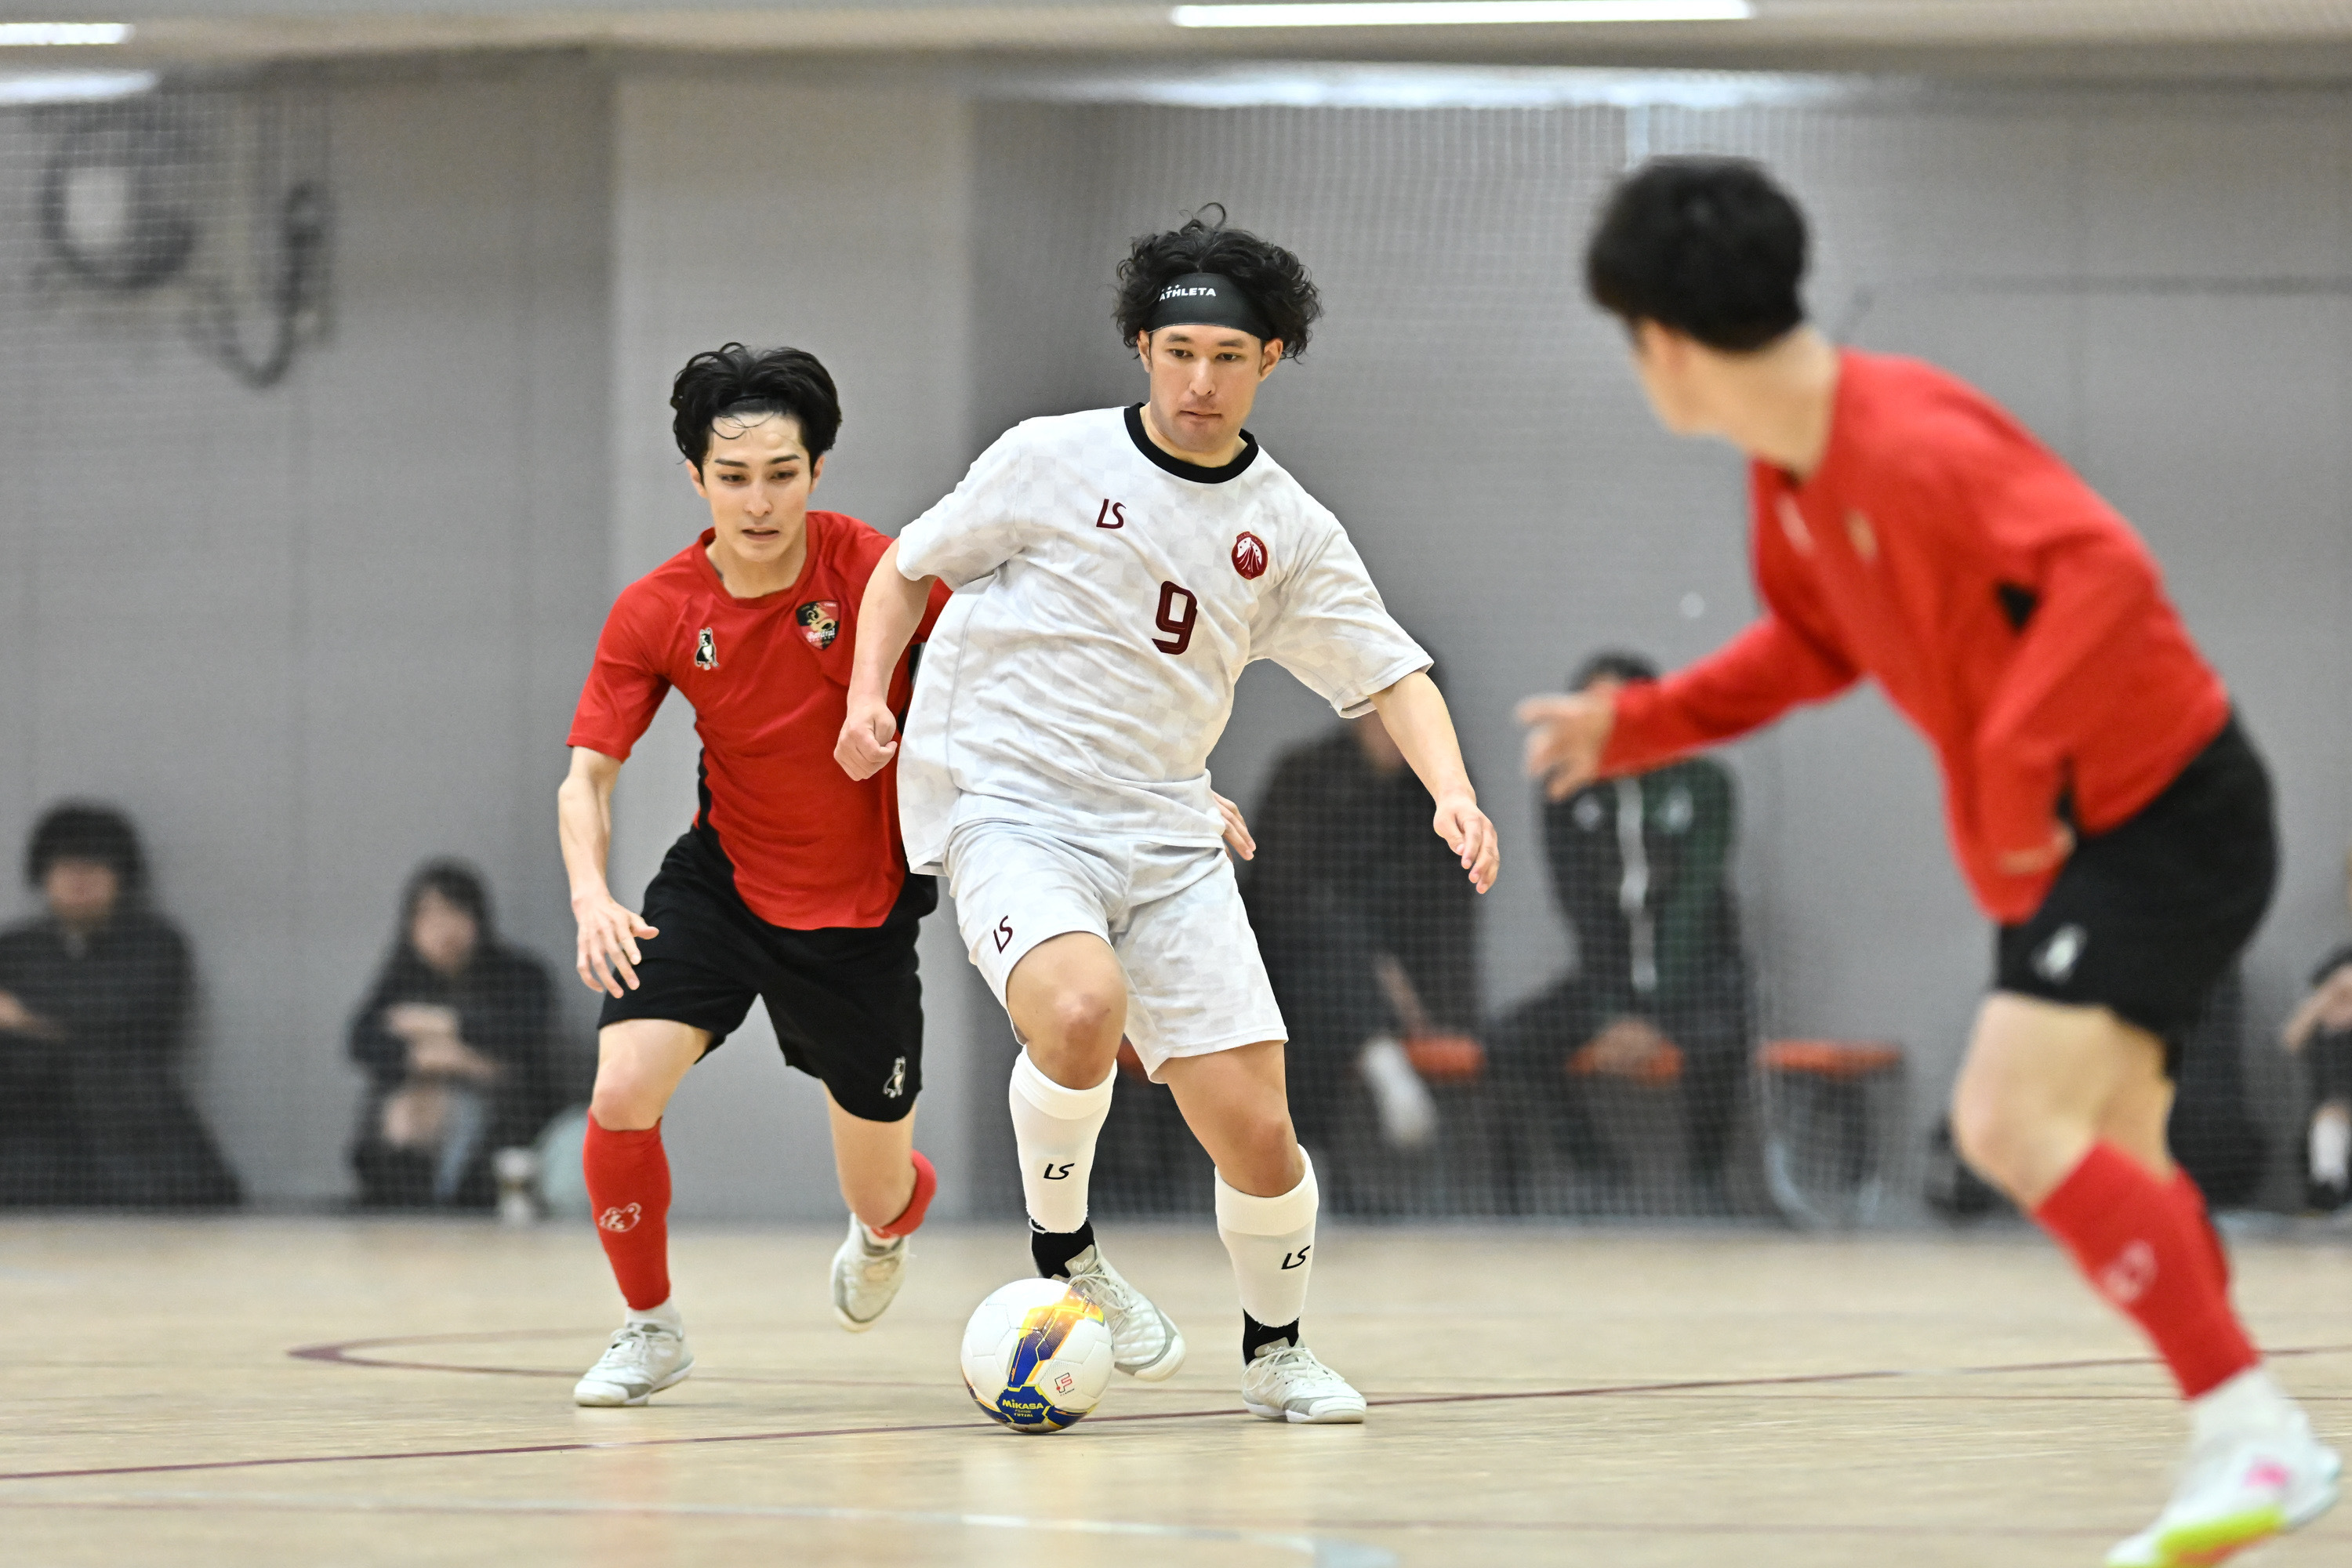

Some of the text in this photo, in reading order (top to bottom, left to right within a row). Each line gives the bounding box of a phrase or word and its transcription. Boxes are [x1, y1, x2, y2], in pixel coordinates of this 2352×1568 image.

[1160, 287, 1216, 301] ATHLETA
[1096, 499, 1126, 529] LS
[1152, 581, 1198, 655] 9
[993, 915, 1013, 954] LS
[1044, 1163, 1075, 1180] LS
[1281, 1245, 1311, 1269] LS
